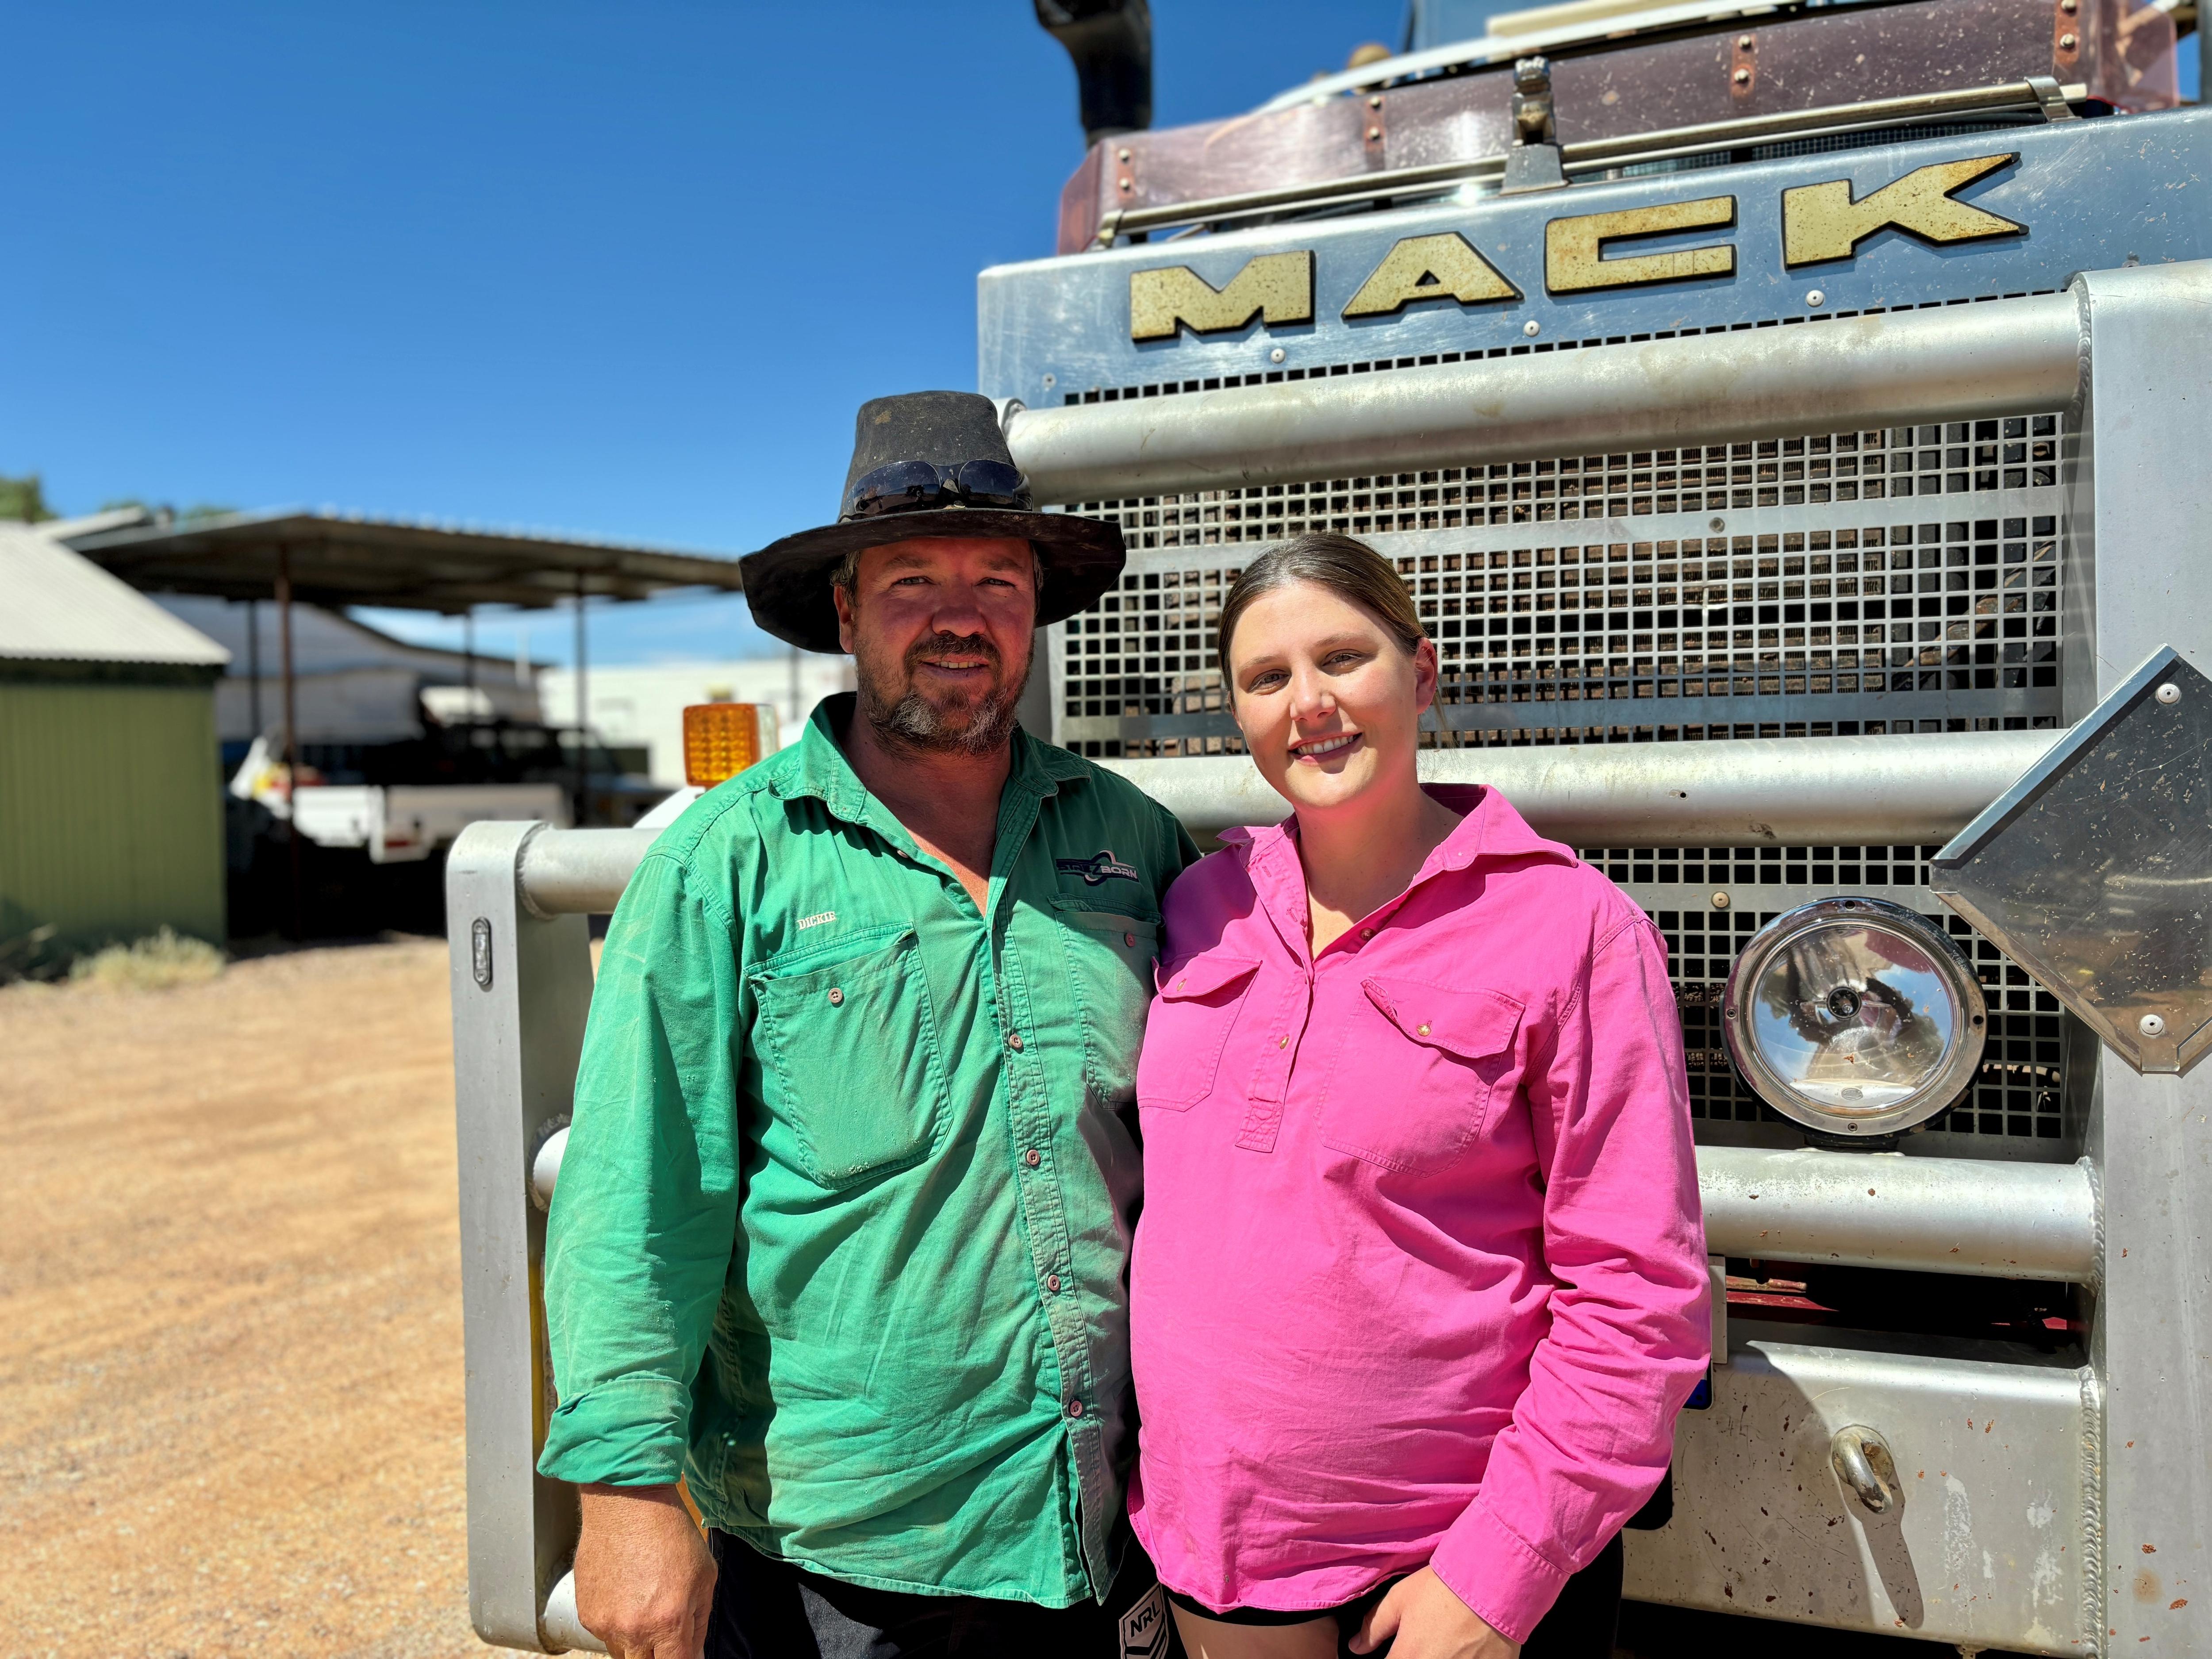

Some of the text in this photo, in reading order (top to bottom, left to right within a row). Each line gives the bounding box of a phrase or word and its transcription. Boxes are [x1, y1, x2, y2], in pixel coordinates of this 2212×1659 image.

[1130, 152, 2029, 343] MACK
[796, 911, 837, 930] DICKIE
[1131, 1601, 1160, 1638] NRL
